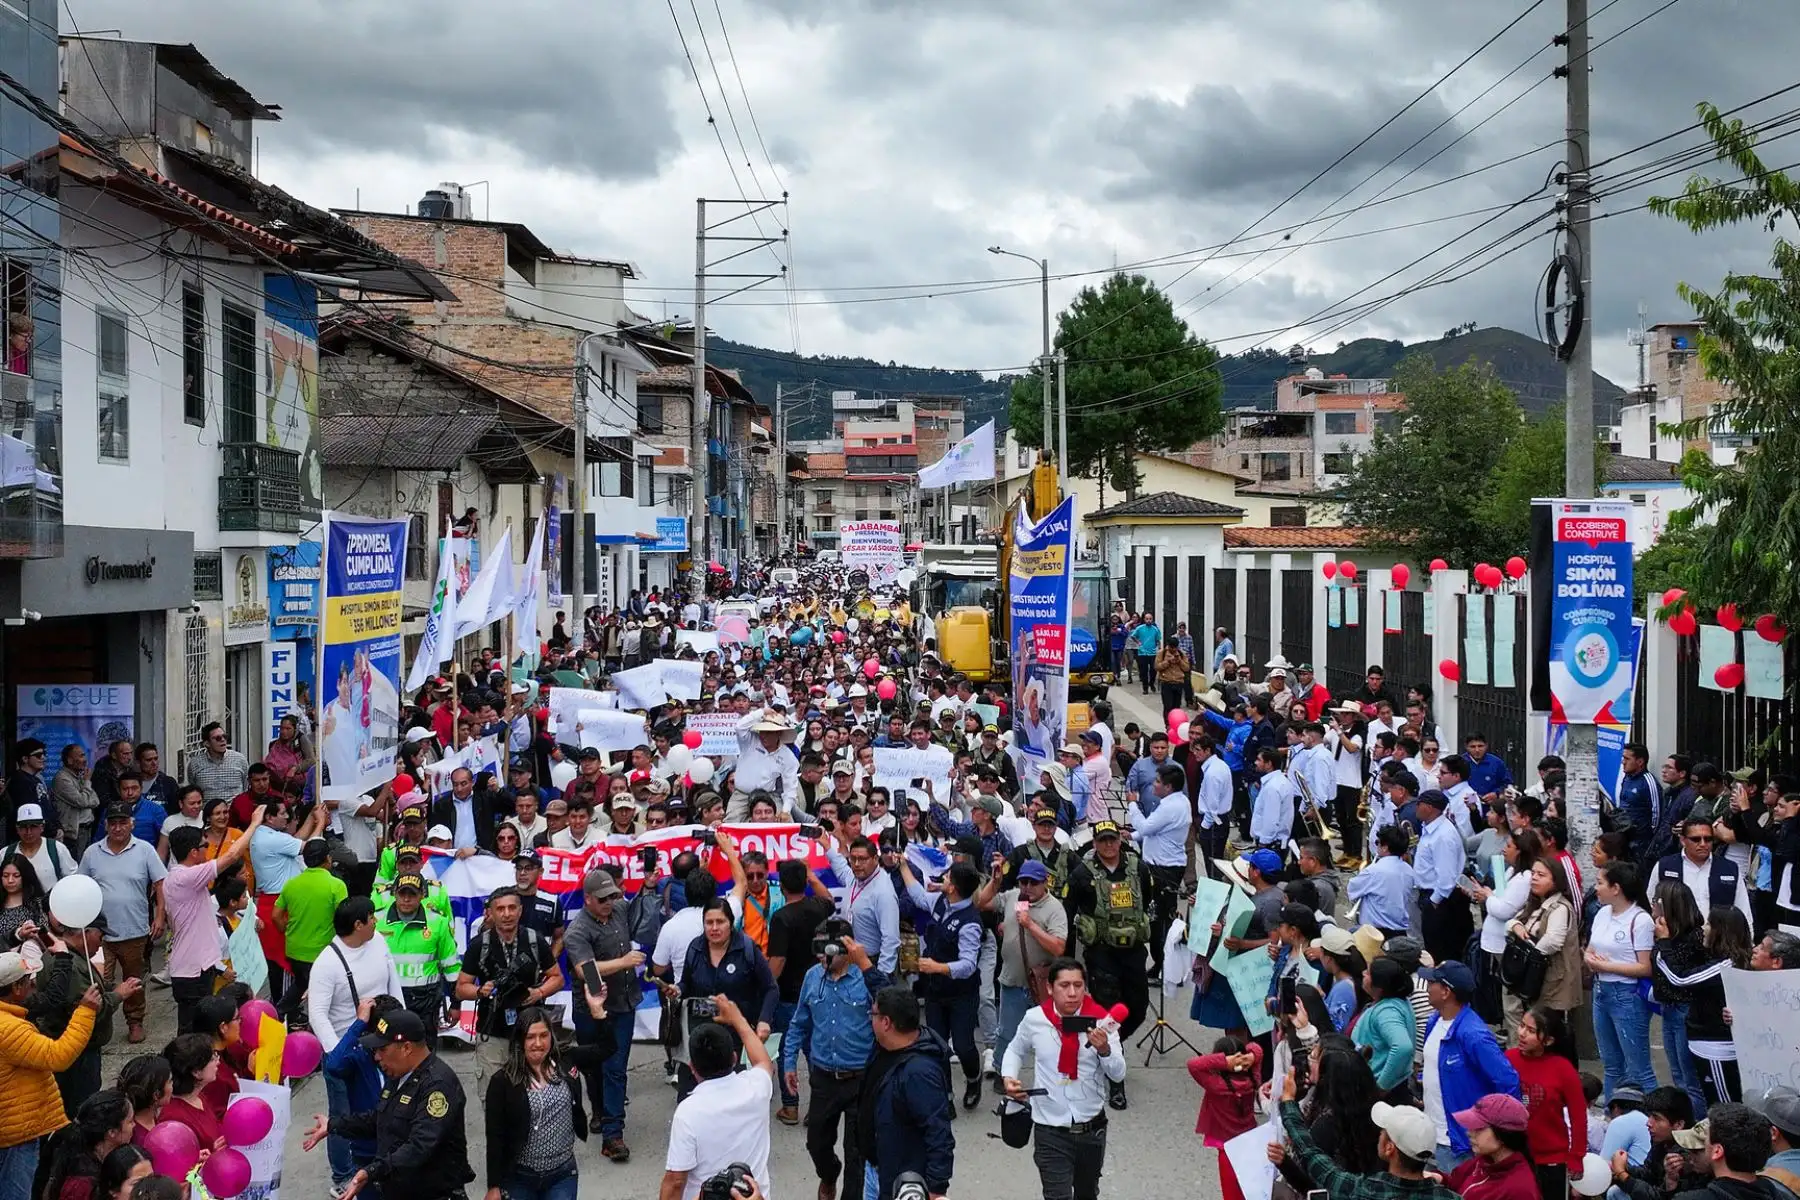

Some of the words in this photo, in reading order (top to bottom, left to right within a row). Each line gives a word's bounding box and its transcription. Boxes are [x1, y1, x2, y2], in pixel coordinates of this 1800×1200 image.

[840, 523, 900, 533] CAJABAMBA
[1565, 522, 1575, 530] EL
[1576, 522, 1619, 531] GOBIERNO
[1564, 530, 1619, 539] CONSTRUYE
[346, 555, 394, 576] CUMPLIDA!
[1568, 555, 1616, 565] HOSPITAL
[1566, 565, 1616, 581] SIMÓN
[1557, 581, 1625, 597] BOLÍVAR
[542, 855, 579, 881] EL
